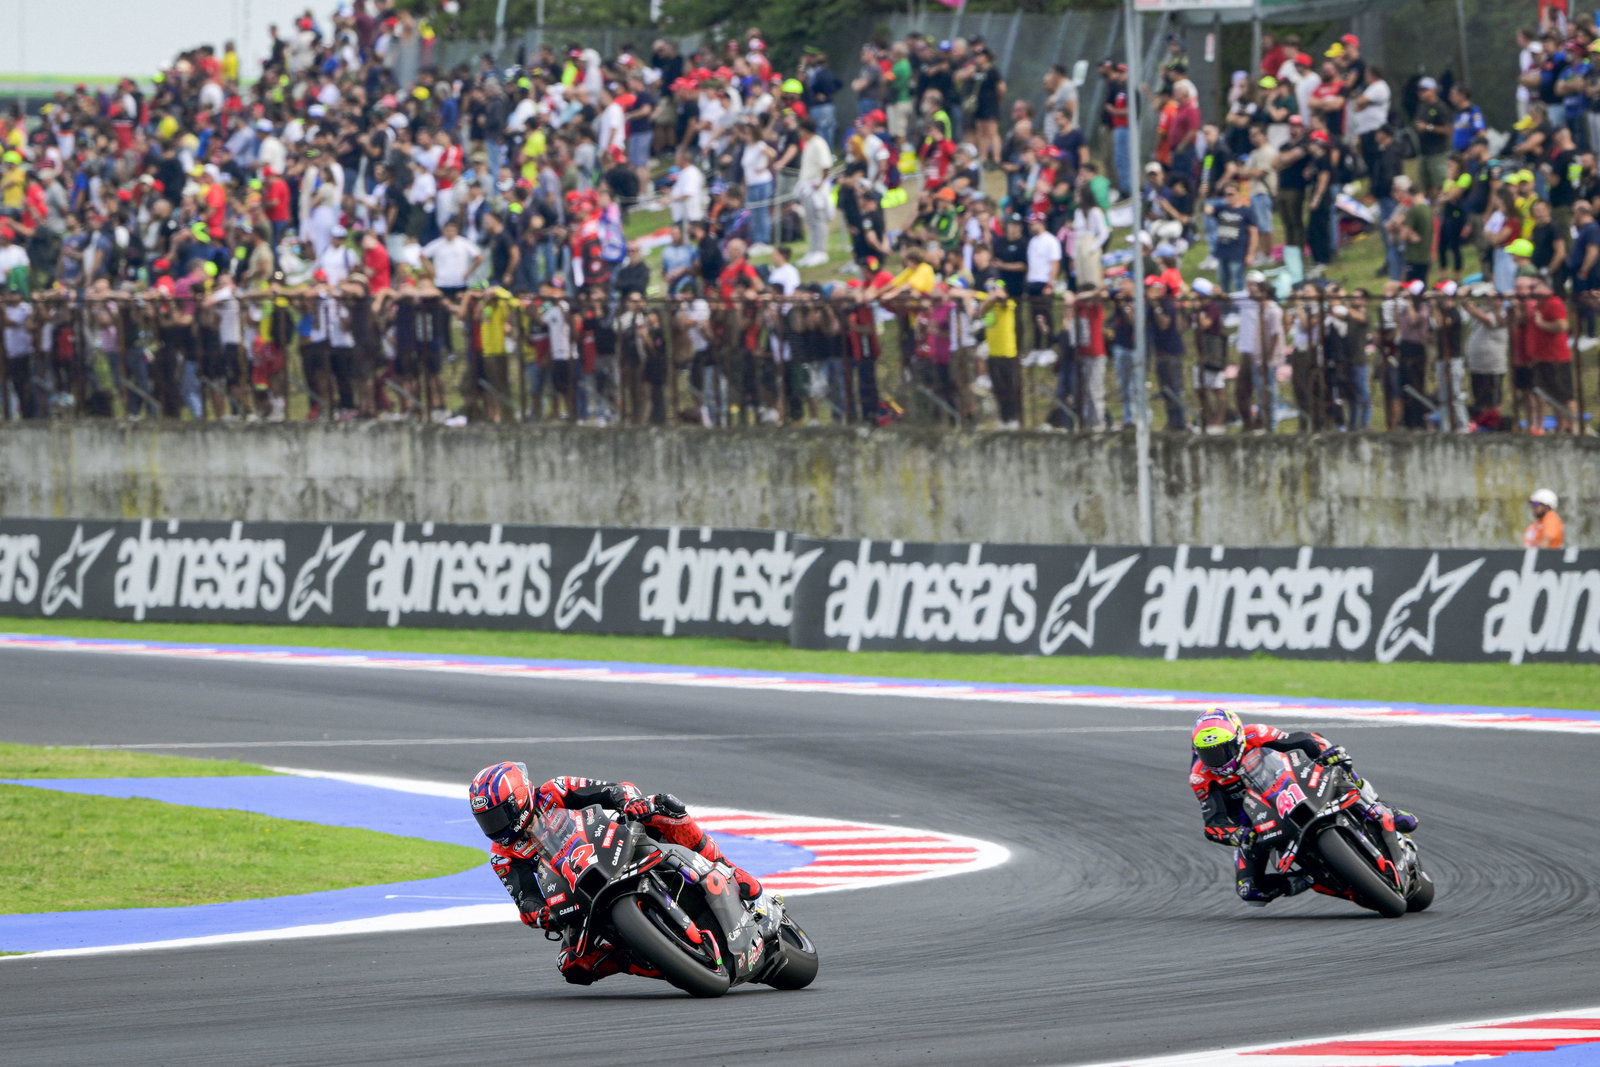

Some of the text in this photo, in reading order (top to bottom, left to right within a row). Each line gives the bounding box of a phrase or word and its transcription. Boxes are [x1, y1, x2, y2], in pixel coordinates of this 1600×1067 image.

[114, 519, 286, 621] alpinestars
[366, 521, 551, 627] alpinestars
[824, 539, 1037, 652] alpinestars
[1140, 544, 1373, 661] alpinestars
[1276, 783, 1308, 819] 41
[561, 843, 598, 894] 12
